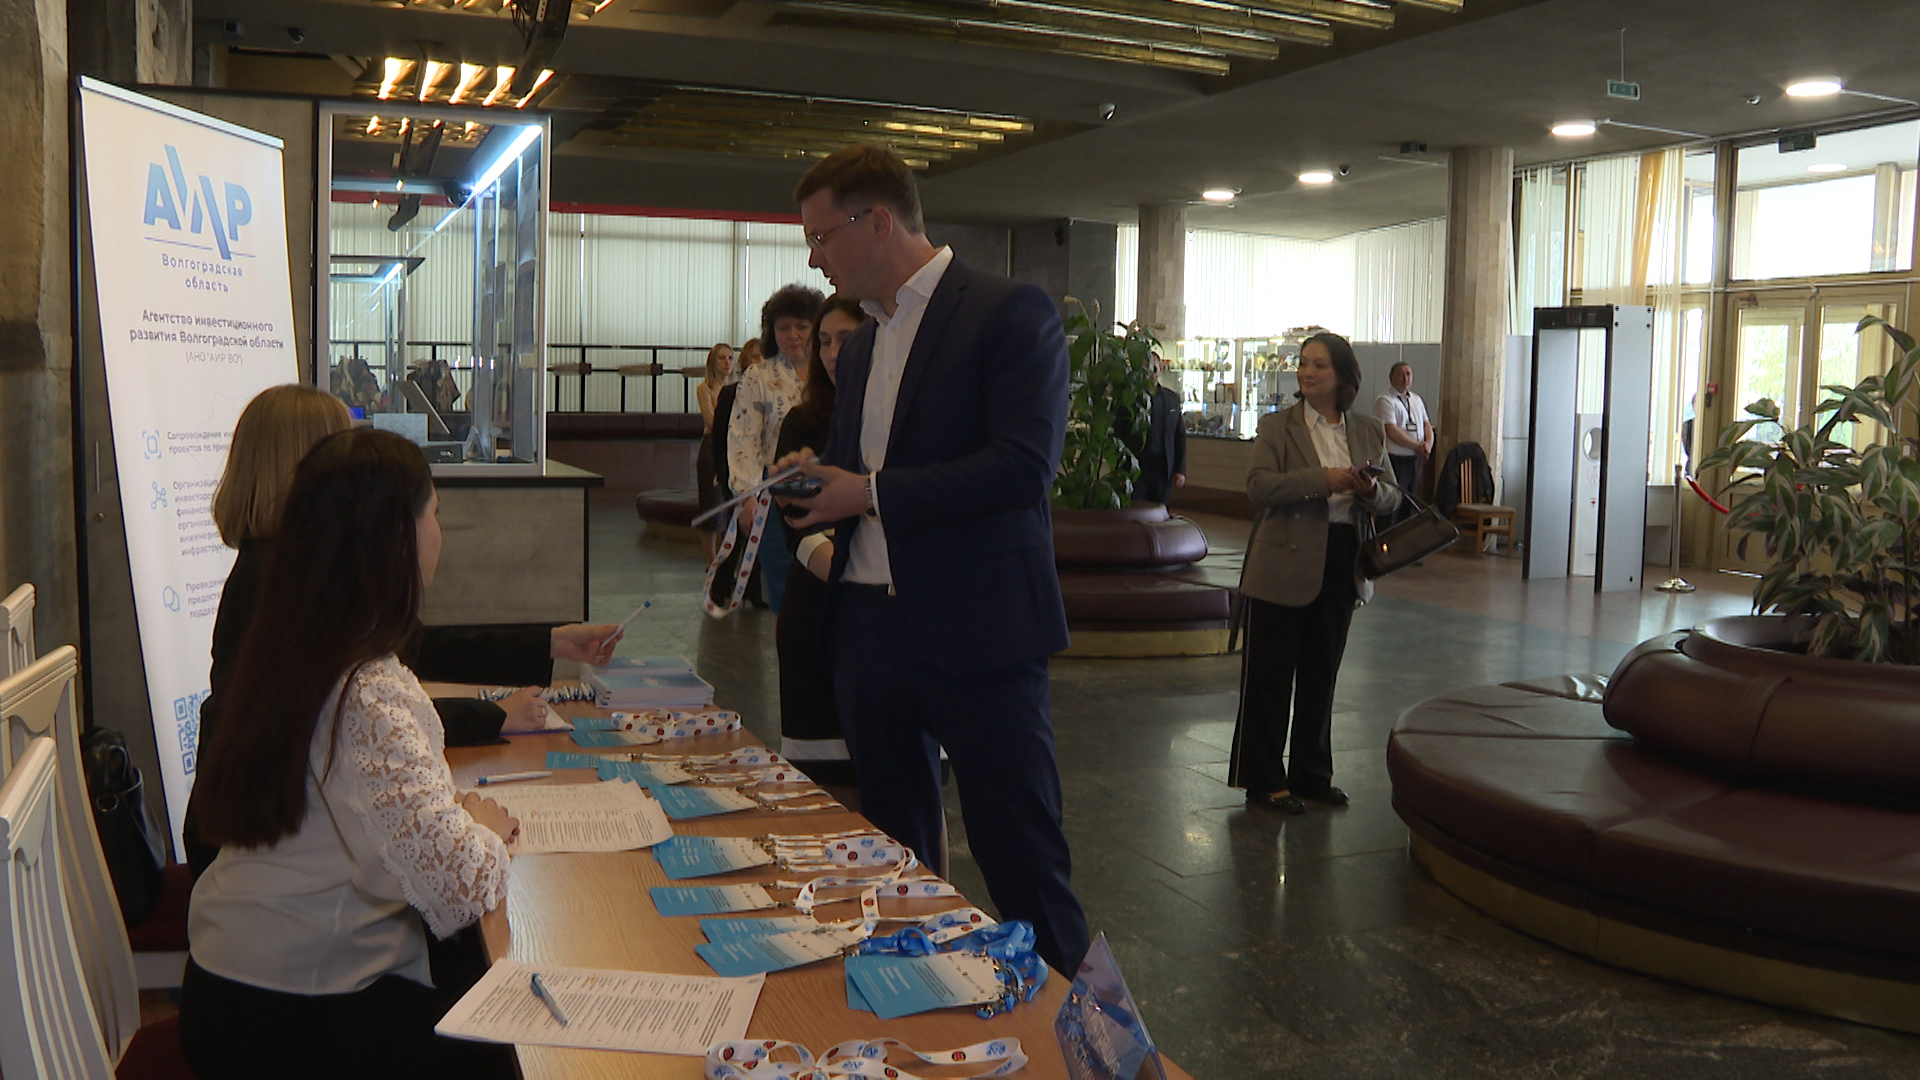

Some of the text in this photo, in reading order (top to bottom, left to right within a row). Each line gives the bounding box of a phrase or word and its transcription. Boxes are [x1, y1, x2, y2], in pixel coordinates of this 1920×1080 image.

[143, 144, 252, 261] АИР
[162, 253, 243, 277] Волгоградская
[185, 275, 229, 293] область
[142, 309, 274, 332] Агентство инвестиционного
[129, 328, 284, 349] развития Волгоградской области
[167, 430, 222, 442] Сопровождение
[169, 444, 202, 455] проектов
[203, 444, 212, 452] по
[172, 478, 218, 491] Организаци
[180, 531, 220, 543] инженерно
